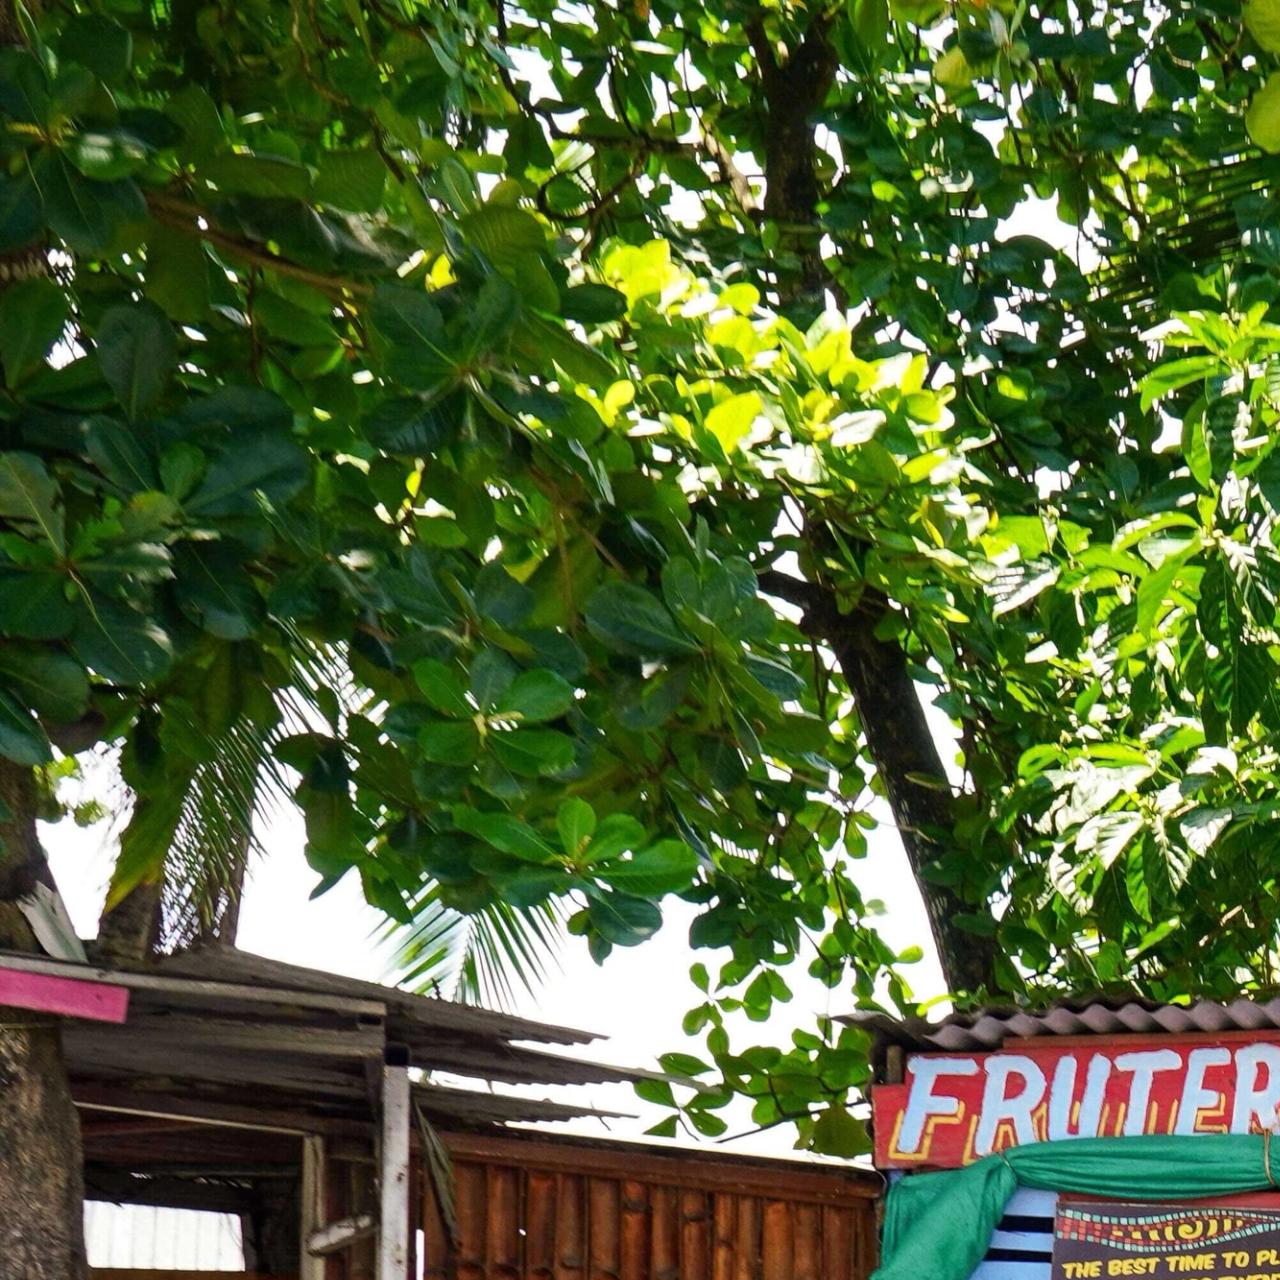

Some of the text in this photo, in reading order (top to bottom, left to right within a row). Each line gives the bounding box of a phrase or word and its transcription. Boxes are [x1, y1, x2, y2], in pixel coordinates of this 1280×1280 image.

[1062, 1260, 1102, 1280] THE
[1107, 1257, 1161, 1277] BEST
[1165, 1253, 1217, 1273] TIME
[1221, 1250, 1250, 1269] TO
